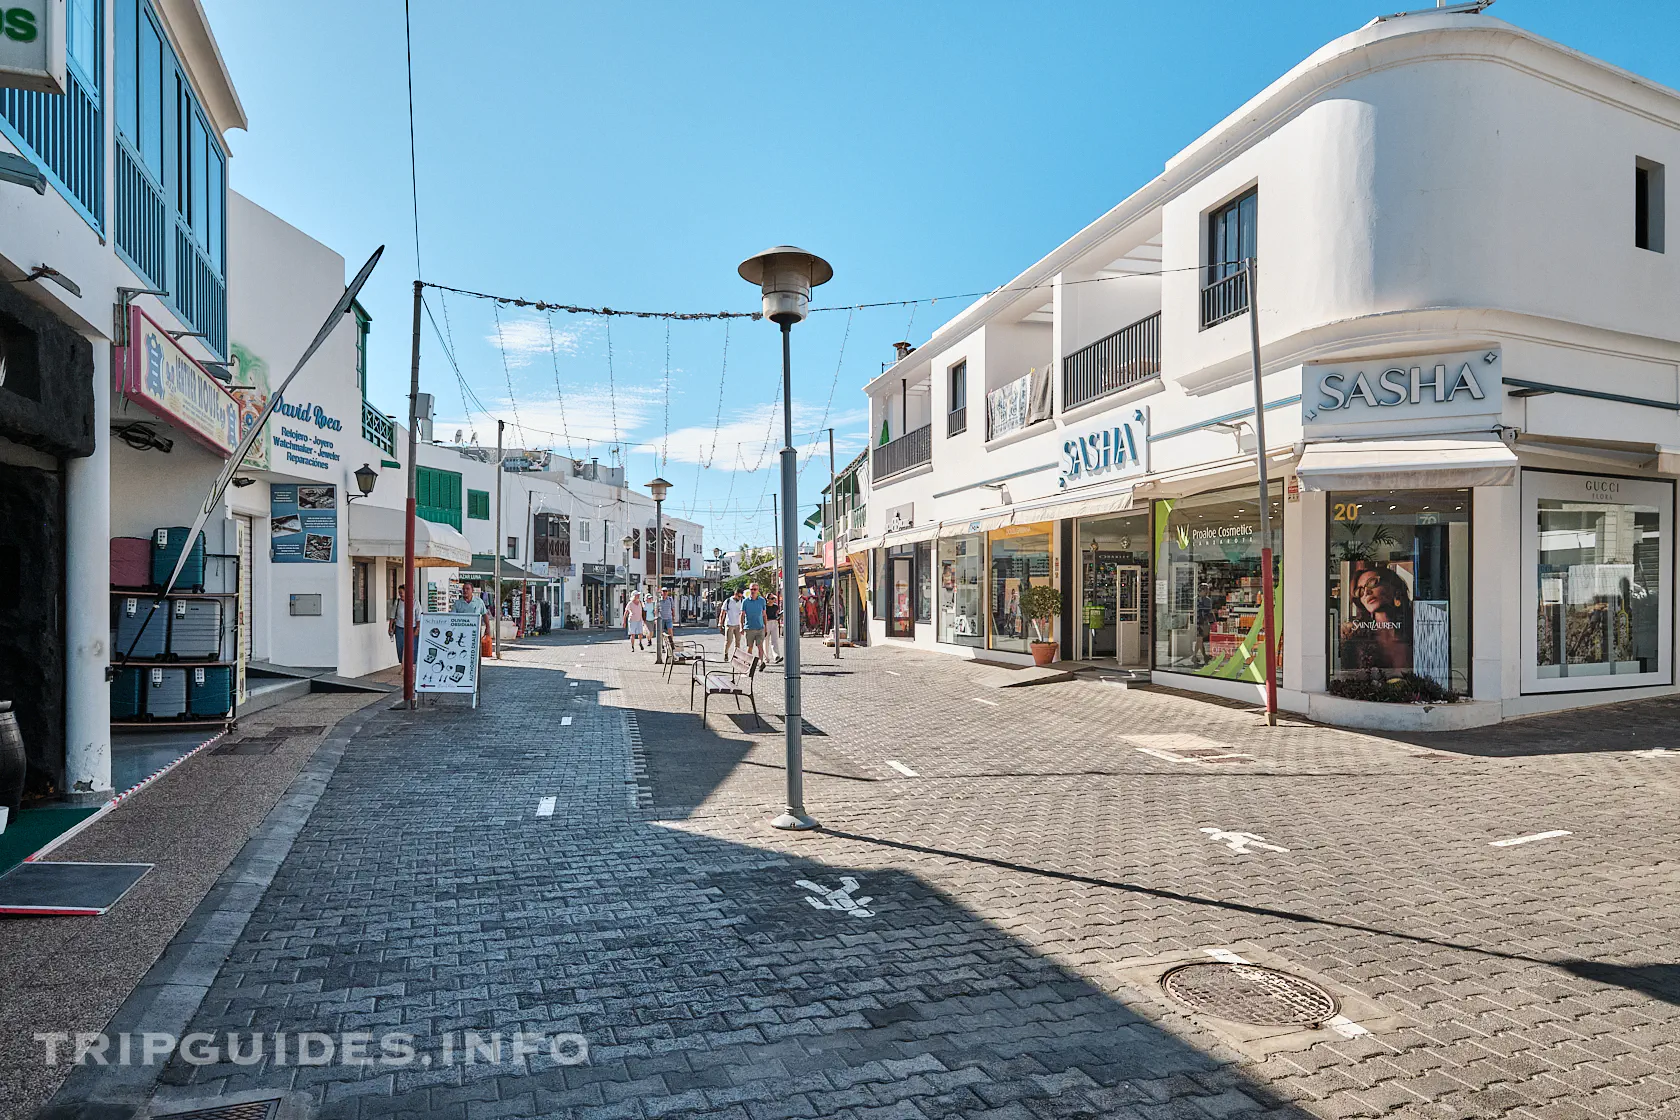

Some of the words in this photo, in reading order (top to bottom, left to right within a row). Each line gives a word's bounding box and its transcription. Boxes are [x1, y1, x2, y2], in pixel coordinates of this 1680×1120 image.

[0, 8, 37, 43] S
[1318, 362, 1485, 411] SASHA
[273, 436, 313, 454] Watchmaker
[318, 448, 340, 461] Jeweler
[281, 426, 308, 442] Relojero
[313, 436, 334, 449] Joyero
[1062, 423, 1137, 476] SASHA
[1585, 480, 1619, 493] GUCCI
[1333, 503, 1358, 521] 20
[1192, 526, 1217, 540] Proaloe
[1218, 523, 1253, 538] Cosmetics
[1192, 537, 1253, 547] LANZAROTE
